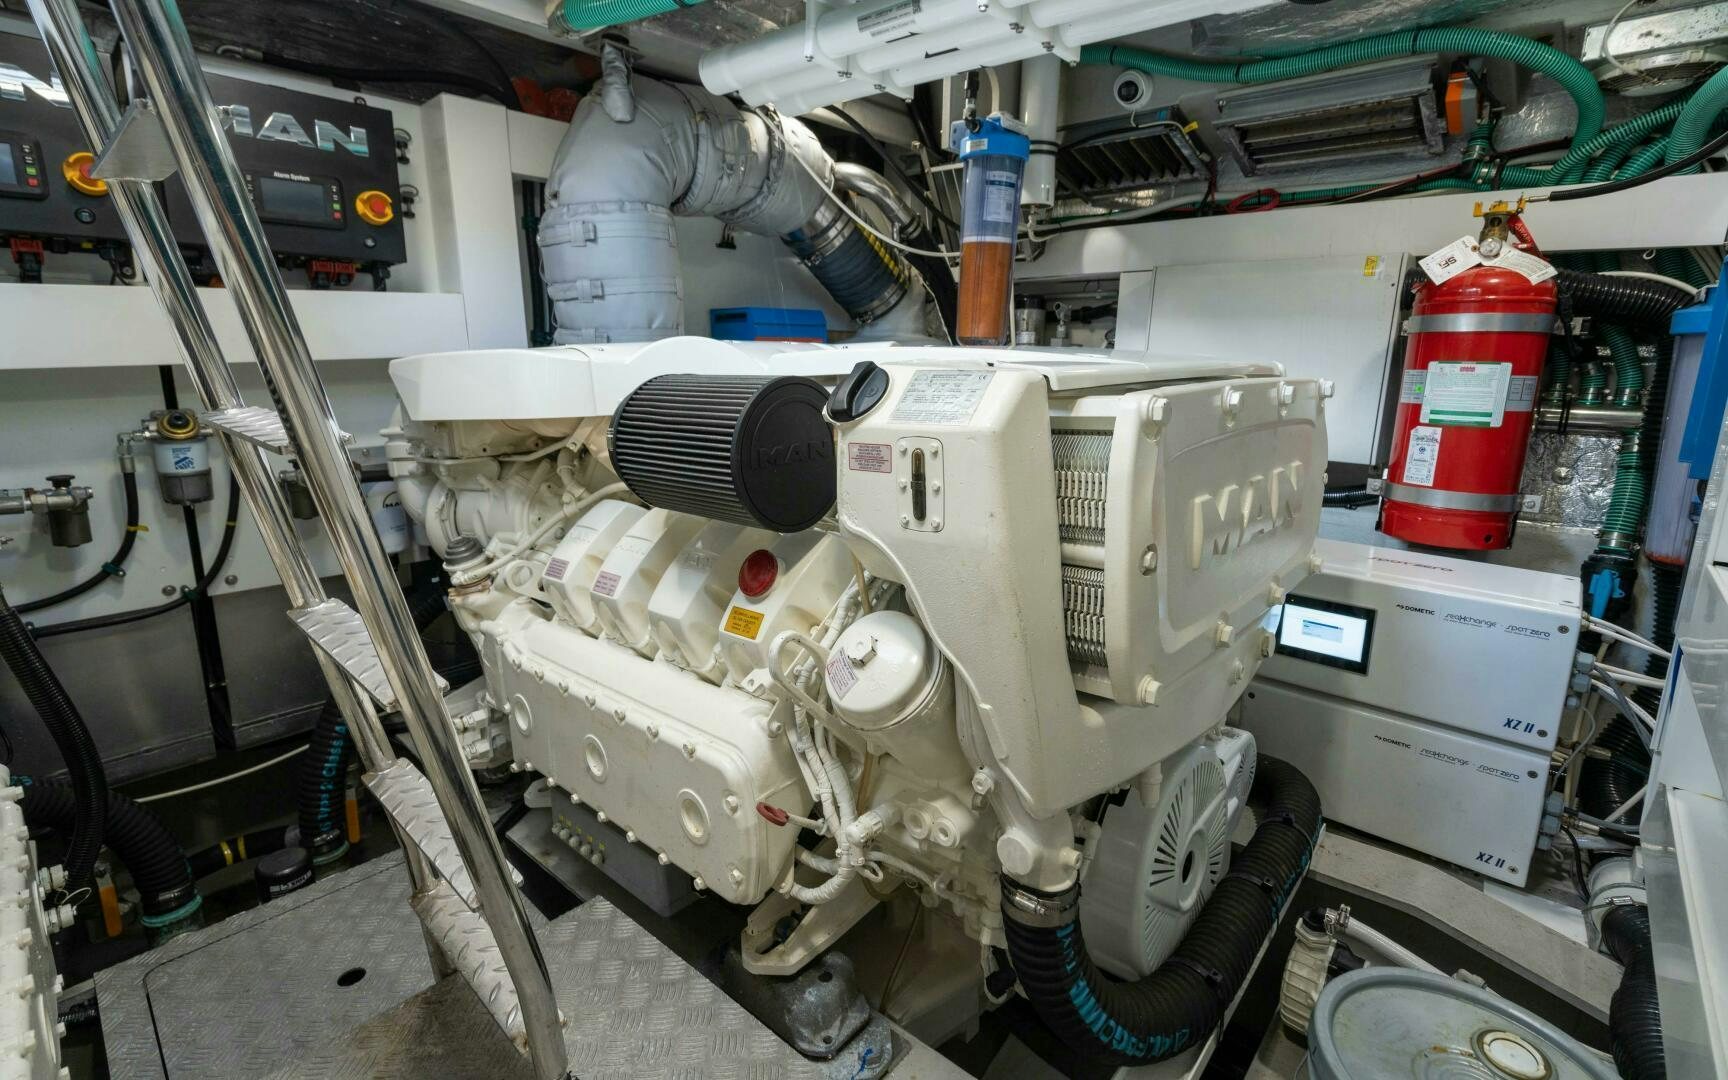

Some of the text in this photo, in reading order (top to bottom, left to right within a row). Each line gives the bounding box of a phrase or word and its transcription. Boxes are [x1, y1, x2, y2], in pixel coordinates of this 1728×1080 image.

[1182, 460, 1303, 571] MAN
[1404, 605, 1436, 616] DOMETIC
[1503, 717, 1535, 734] XZ II
[1382, 737, 1412, 750] DOMETIC
[322, 739, 344, 778] Class
[1476, 851, 1506, 869] XZ II
